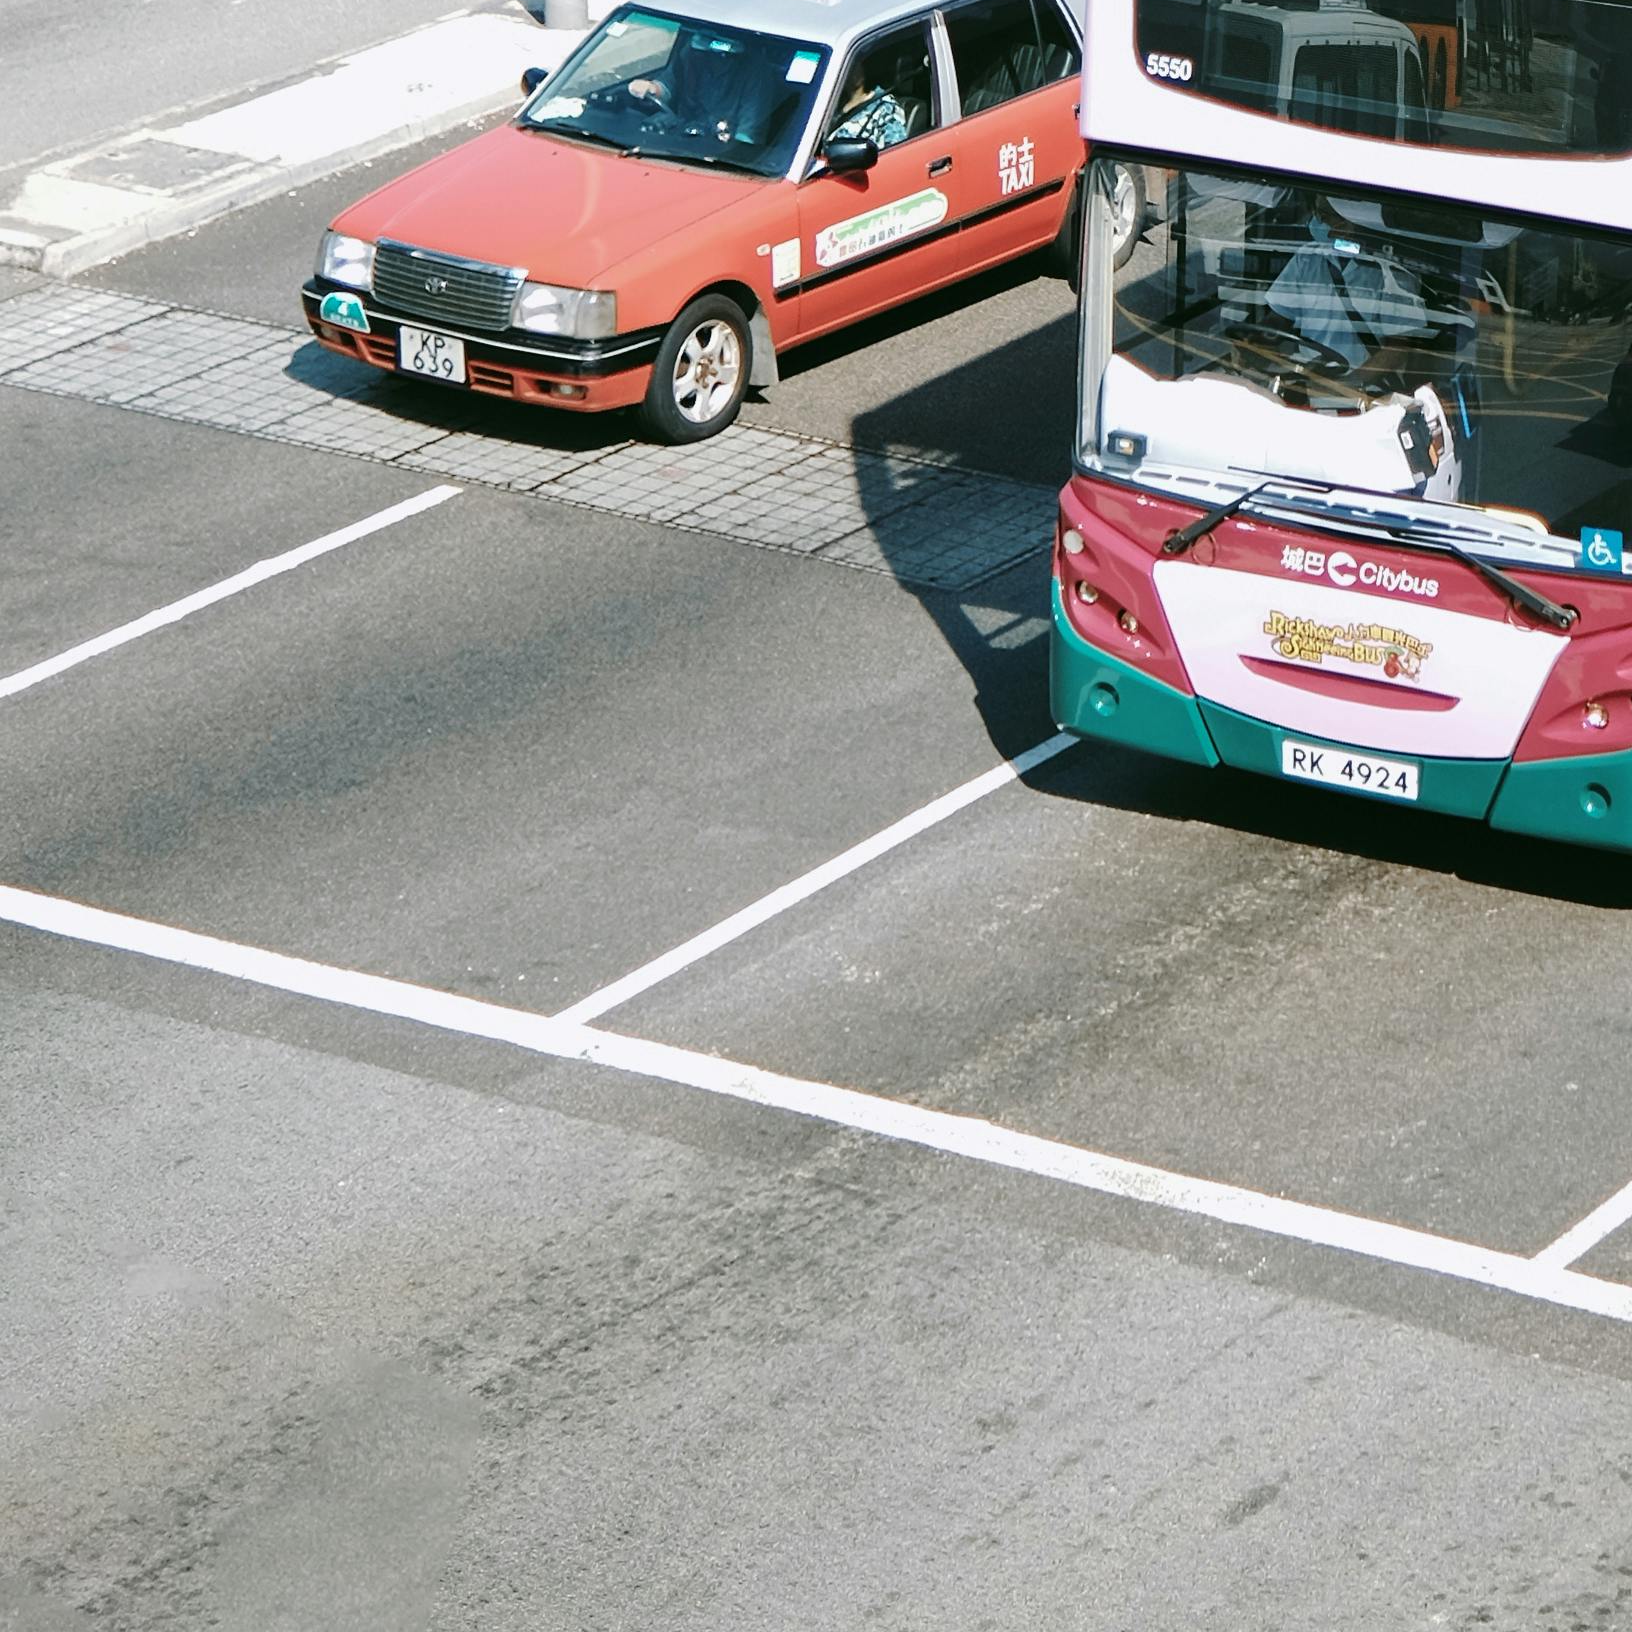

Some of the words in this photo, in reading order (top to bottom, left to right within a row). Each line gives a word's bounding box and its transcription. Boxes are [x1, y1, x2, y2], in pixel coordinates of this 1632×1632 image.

[1147, 53, 1193, 82] 5550
[999, 137, 1035, 166] 的士
[999, 160, 1035, 195] TAXI
[420, 332, 446, 358] KP
[413, 349, 454, 378] 639
[1281, 545, 1325, 576] 城巴
[1359, 562, 1439, 597] Citybus
[1293, 748, 1324, 776] RK
[1341, 760, 1407, 793] 4924
